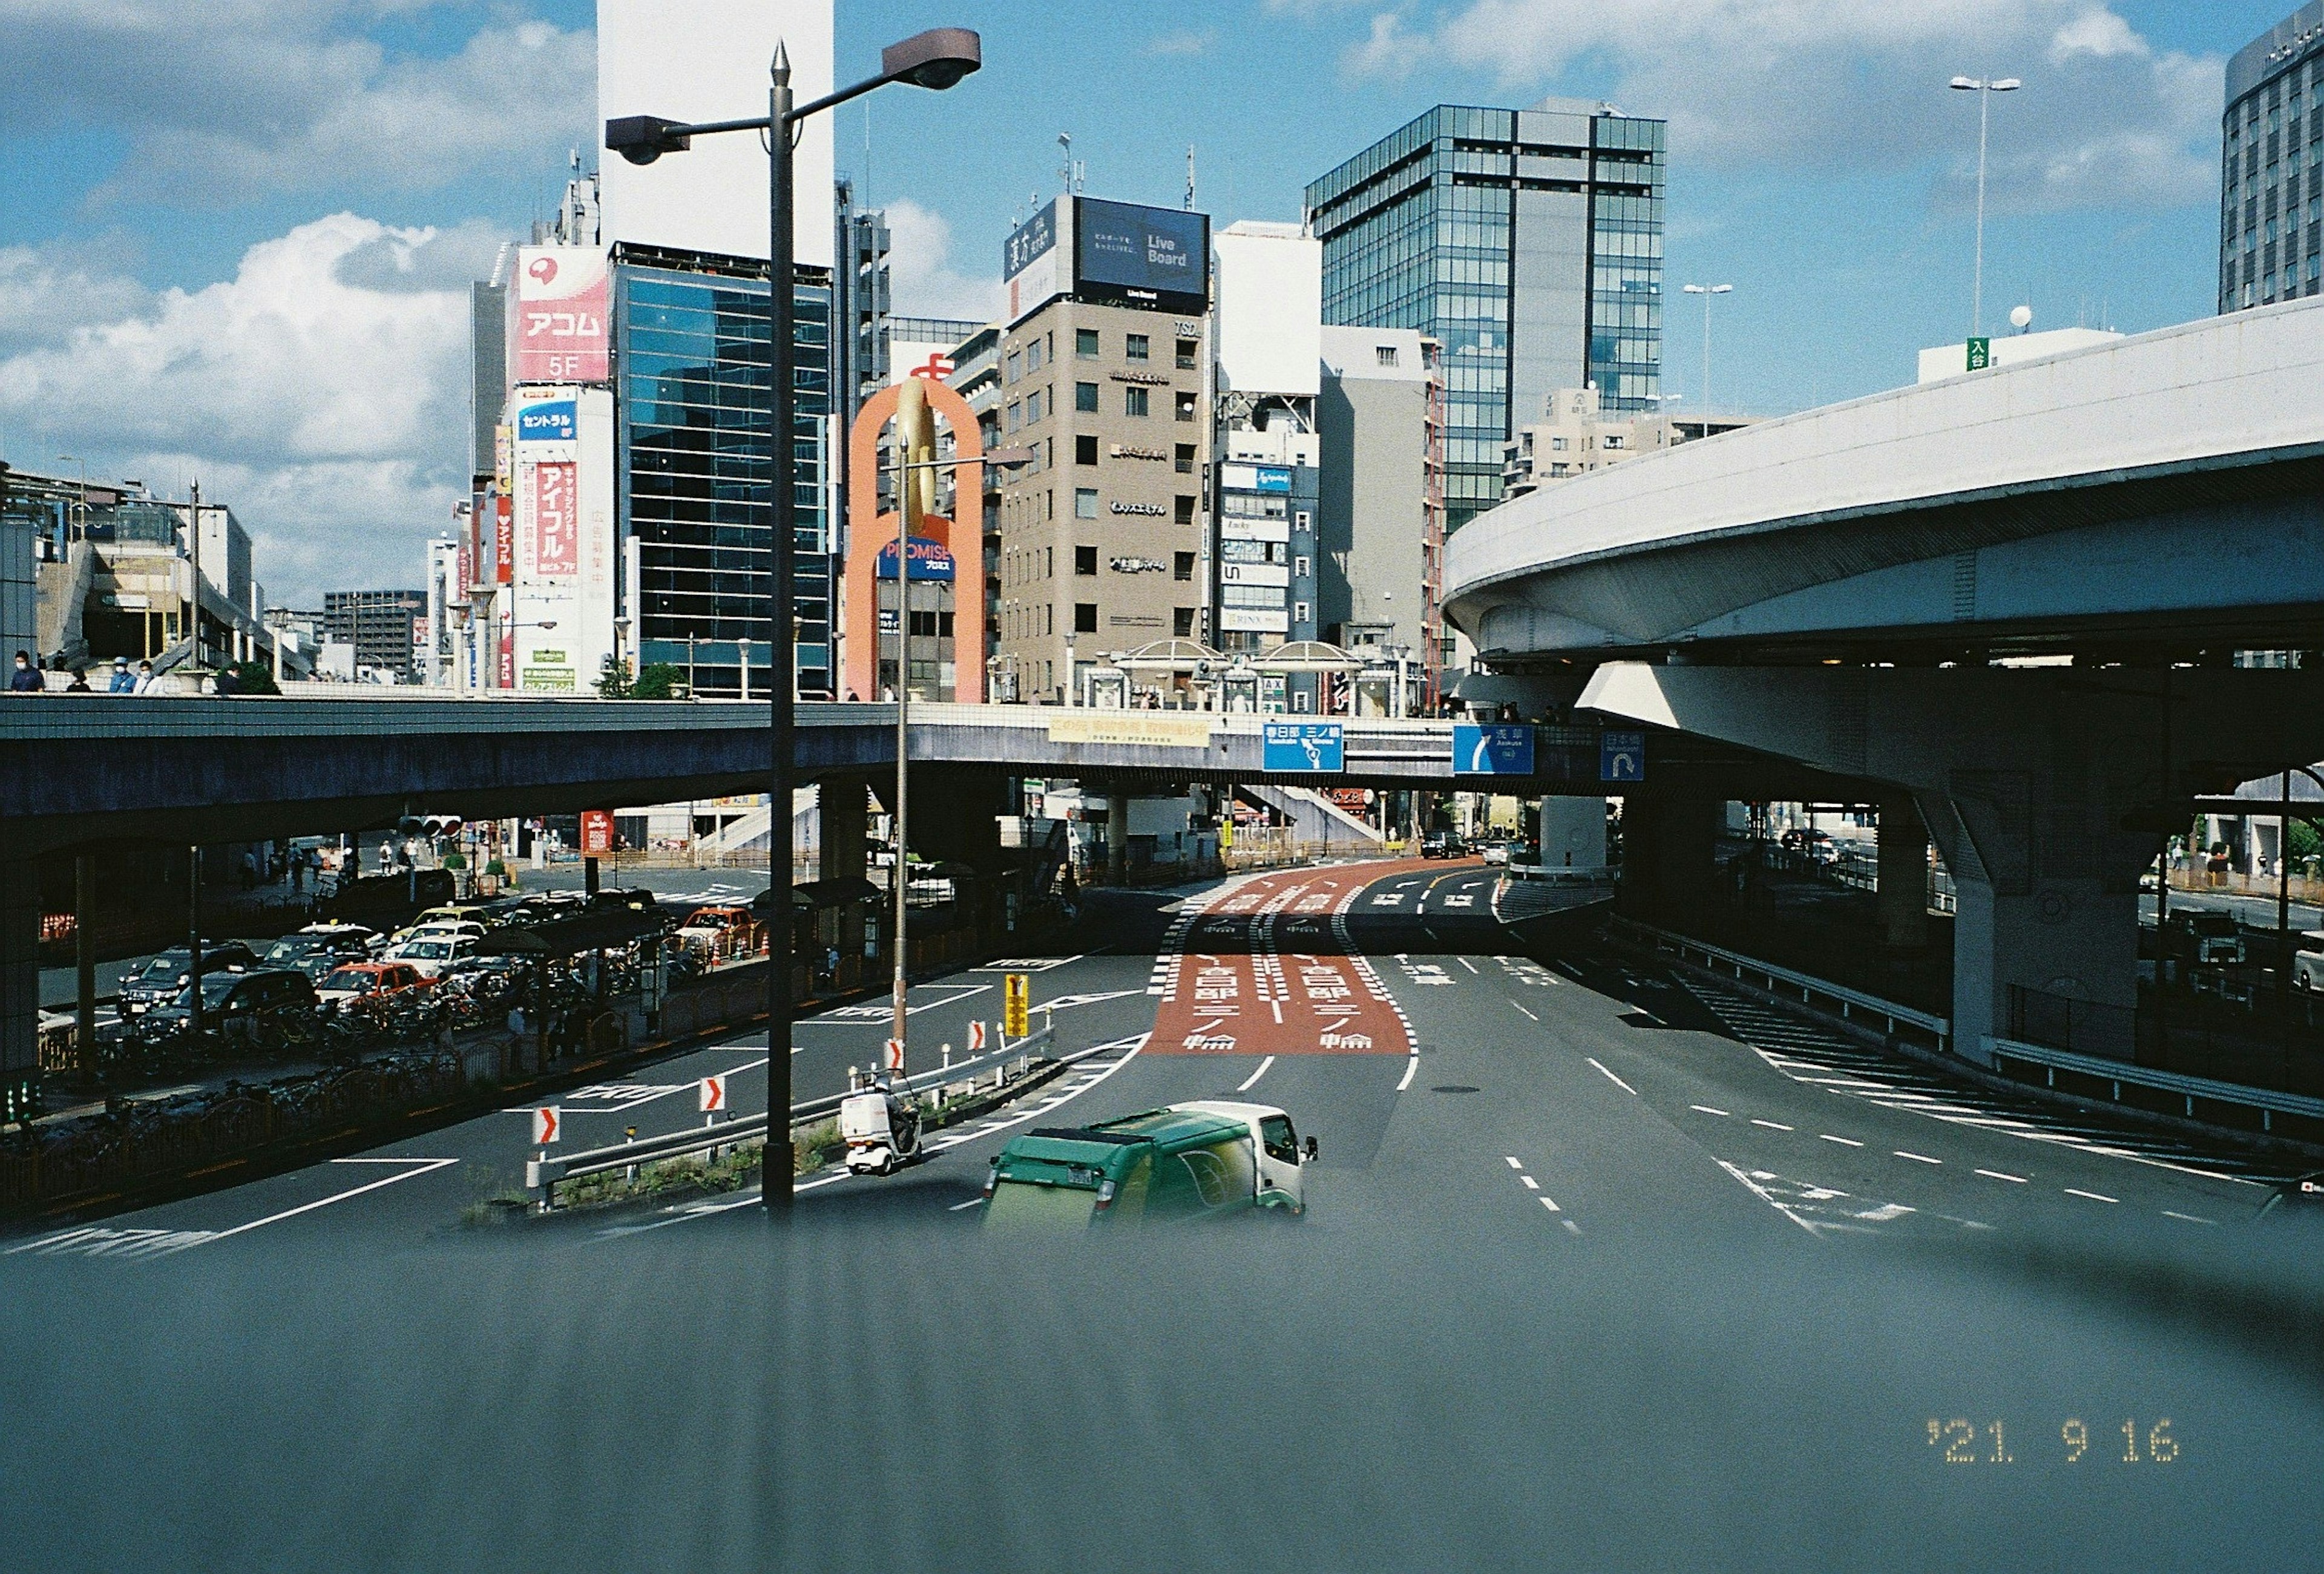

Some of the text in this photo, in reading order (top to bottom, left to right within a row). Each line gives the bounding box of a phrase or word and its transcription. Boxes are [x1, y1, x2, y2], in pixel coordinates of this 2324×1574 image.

[1147, 234, 1175, 251] Live
[1147, 249, 1187, 267] Board
[527, 312, 600, 337] アコム
[1175, 320, 1196, 337] TSD
[548, 356, 579, 376] 5F
[523, 414, 571, 428] セントラル
[542, 467, 564, 559] アイフル
[498, 526, 511, 565] アイフル
[886, 542, 951, 561] POMISE
[925, 560, 950, 571] プロミス
[1265, 726, 1341, 738] 春日部 三ノ輪
[1495, 729, 1523, 740] 浅草
[1606, 733, 1641, 745] 日本橋
